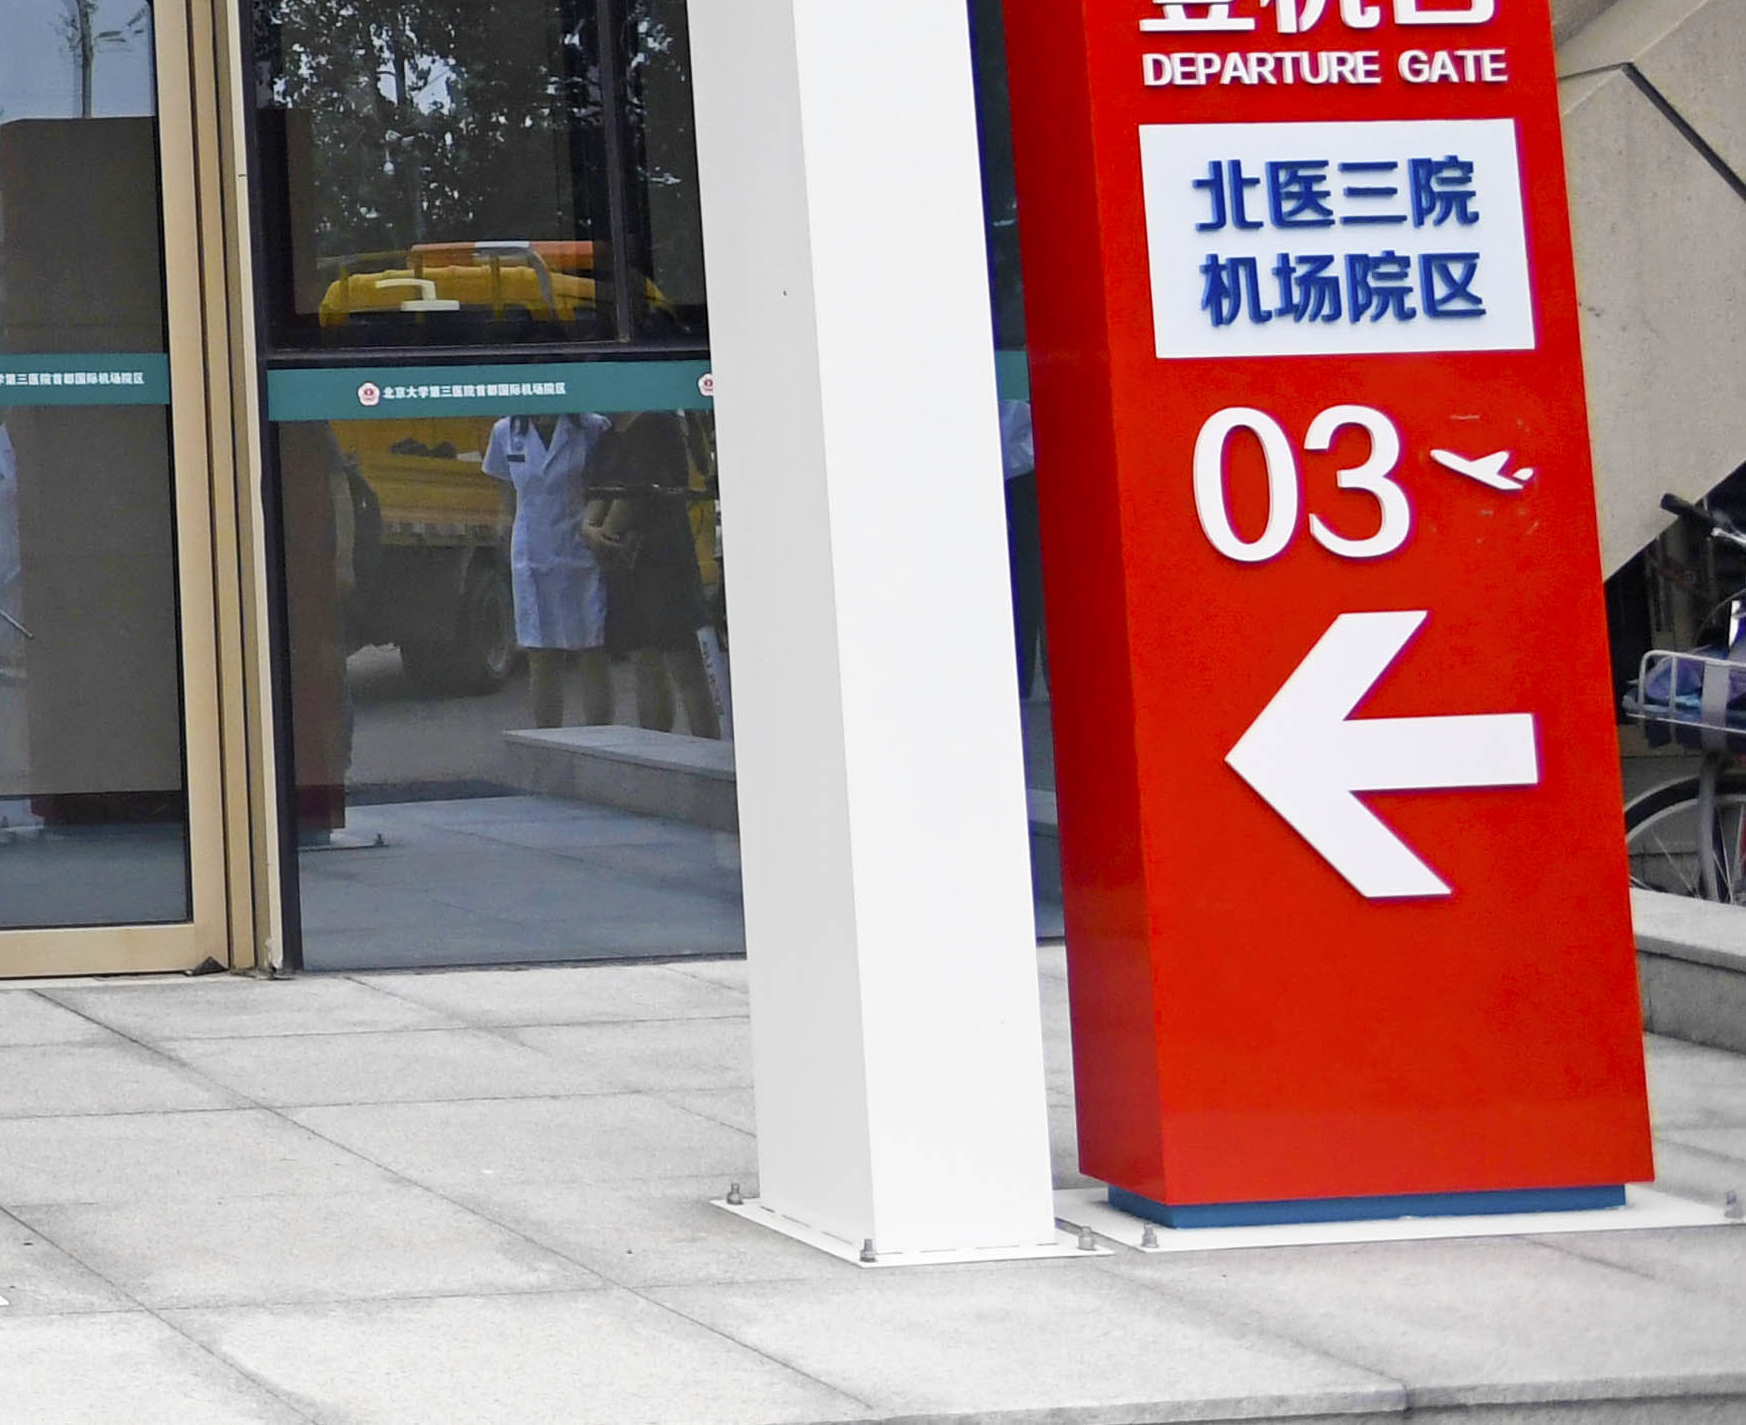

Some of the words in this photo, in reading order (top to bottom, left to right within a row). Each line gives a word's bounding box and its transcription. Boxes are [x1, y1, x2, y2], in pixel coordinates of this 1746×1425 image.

[1142, 51, 1381, 87] DEPARTURE
[1398, 49, 1508, 84] GATE
[1193, 155, 1479, 232] 北医三院
[1200, 250, 1486, 327] 机场院区
[1193, 405, 1414, 564] 03
